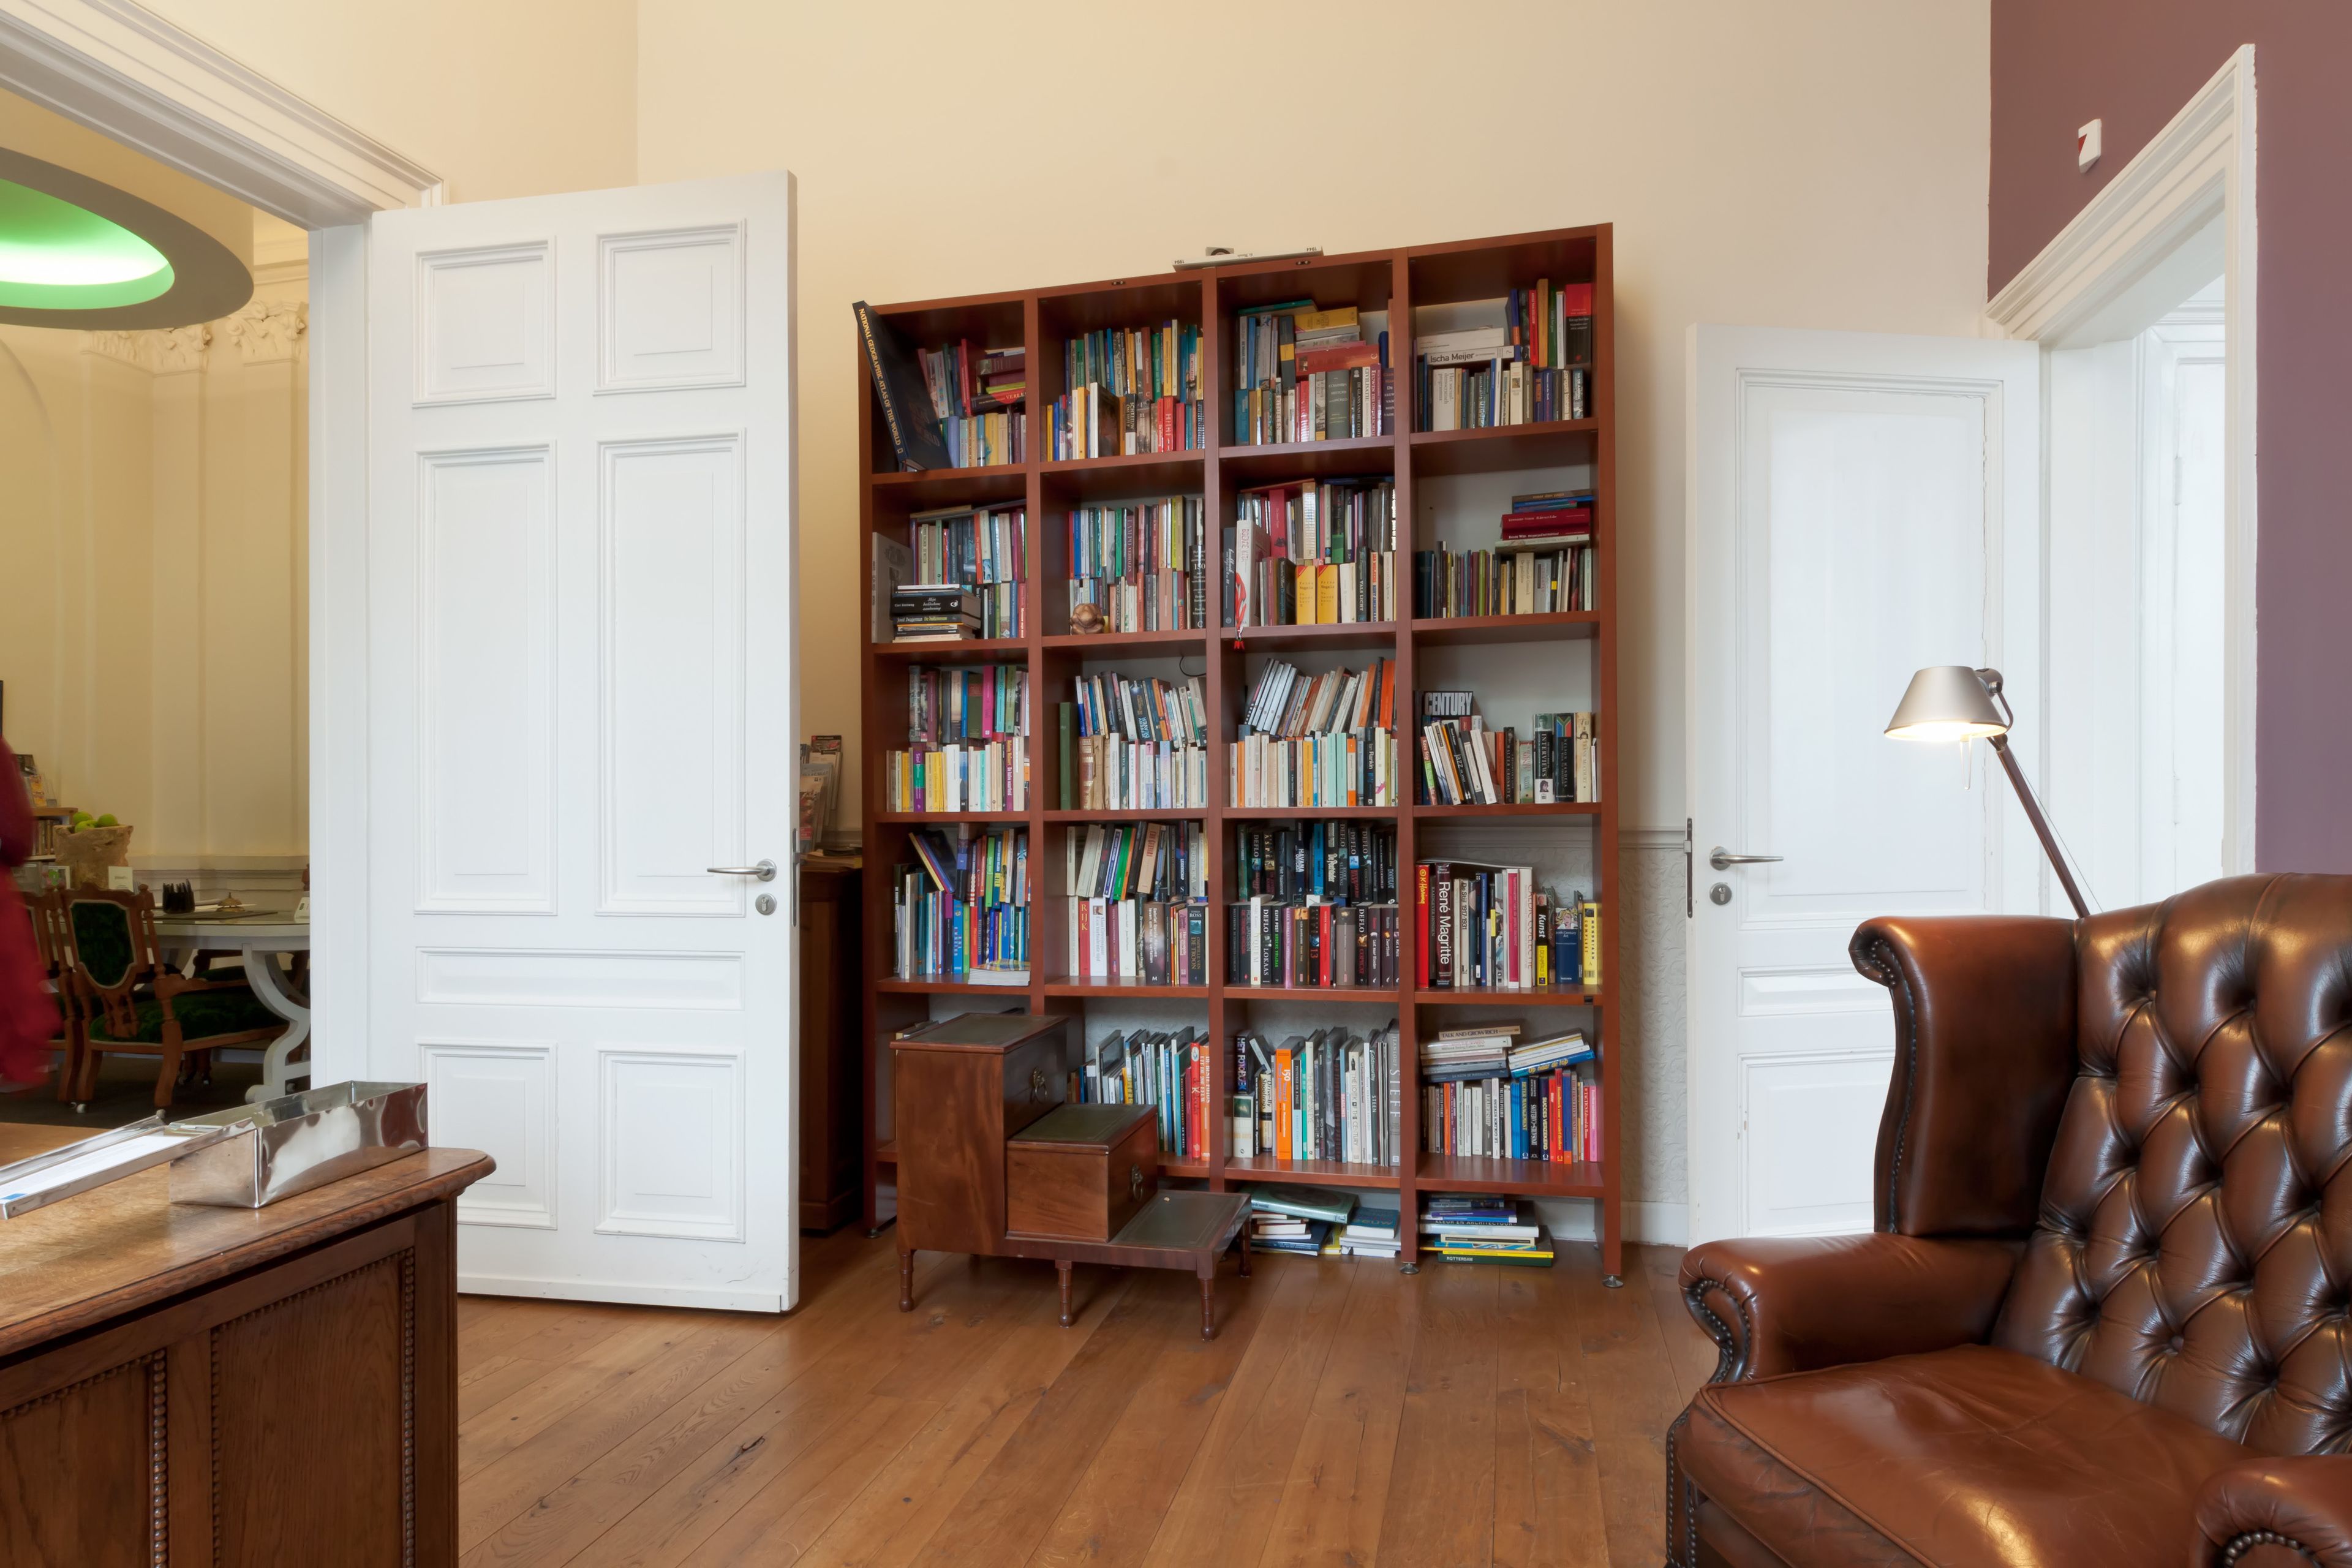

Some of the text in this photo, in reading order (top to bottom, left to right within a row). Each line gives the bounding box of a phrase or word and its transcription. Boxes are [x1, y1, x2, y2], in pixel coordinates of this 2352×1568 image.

[859, 308, 873, 339] NATIONAL
[867, 339, 883, 380] GEOGRAPHIC
[1430, 352, 1475, 363] Ischa Meijer
[879, 380, 889, 399] ATLAS
[886, 409, 895, 422] THE
[890, 422, 901, 445] WORLD
[1425, 692, 1472, 715] CENTURY
[1438, 881, 1451, 964] René Magritte
[1191, 937, 1196, 947] DE
[1311, 949, 1319, 959] 13
[1206, 1056, 1210, 1065] DE
[1237, 1055, 1246, 1090] FOTOBOEK
[1281, 1069, 1291, 1081] 150
[1389, 1069, 1400, 1117] SIEFF
